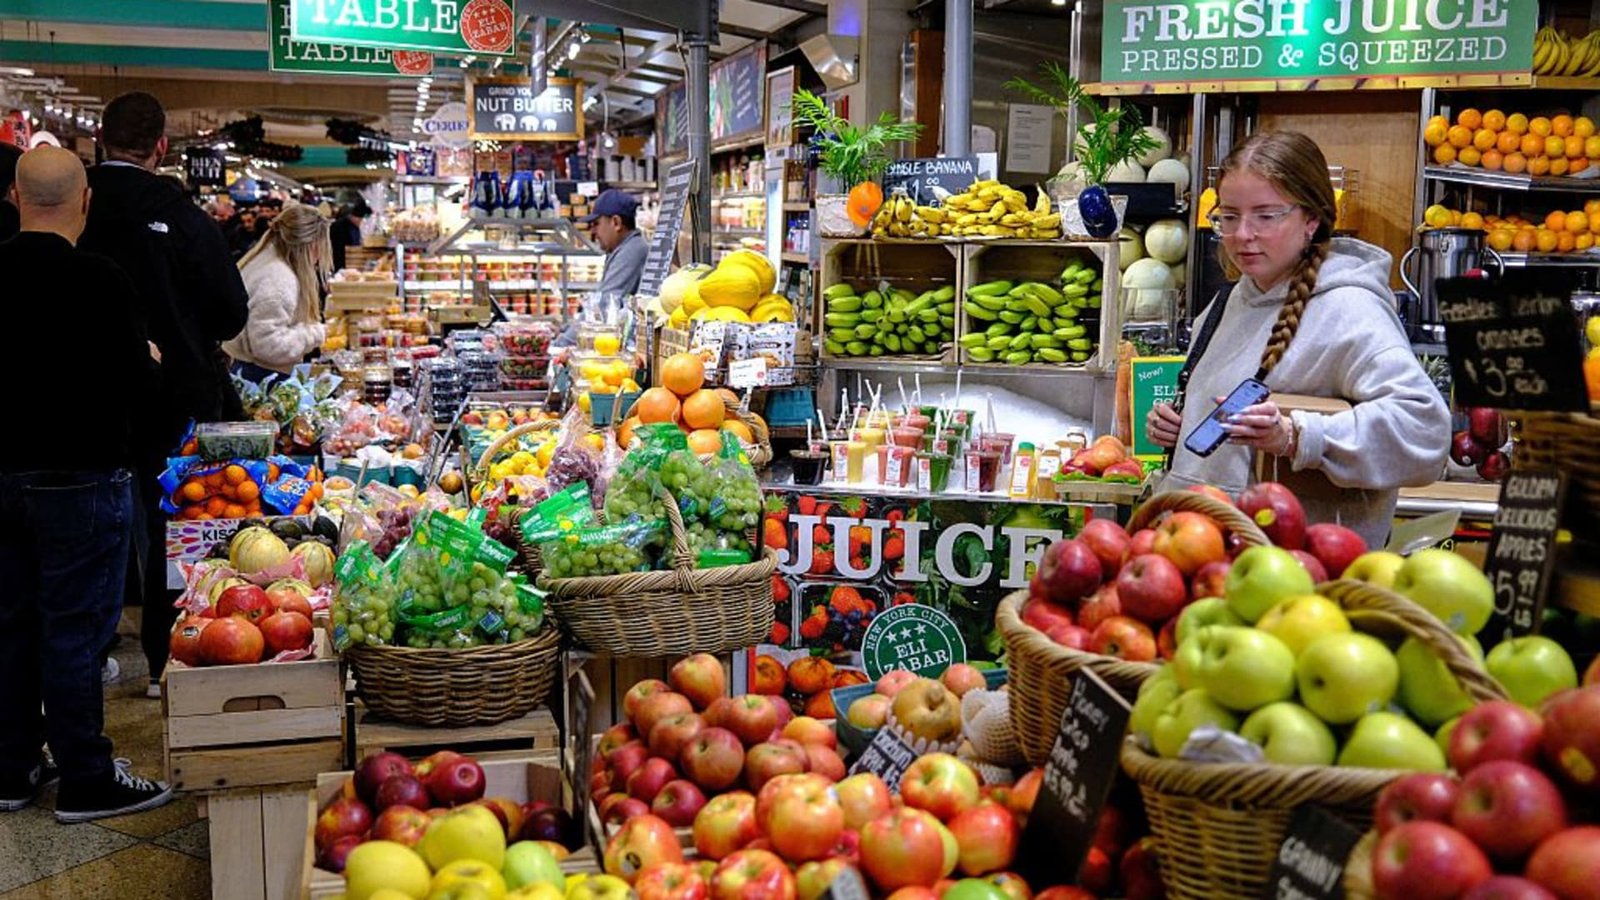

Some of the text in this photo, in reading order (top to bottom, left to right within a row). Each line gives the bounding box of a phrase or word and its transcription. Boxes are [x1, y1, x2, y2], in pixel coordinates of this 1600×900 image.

[303, 0, 458, 33] TABLE
[1121, 0, 1509, 43] FRESH JUICE
[1121, 36, 1507, 72] PRESSED & SQUEEZED
[476, 98, 508, 112] NUT
[926, 160, 973, 174] BANANA
[777, 513, 1063, 589] JUICE
[1495, 533, 1547, 562] APPLES
[865, 607, 950, 651] NEW YORK CITY
[894, 638, 928, 659] ELI
